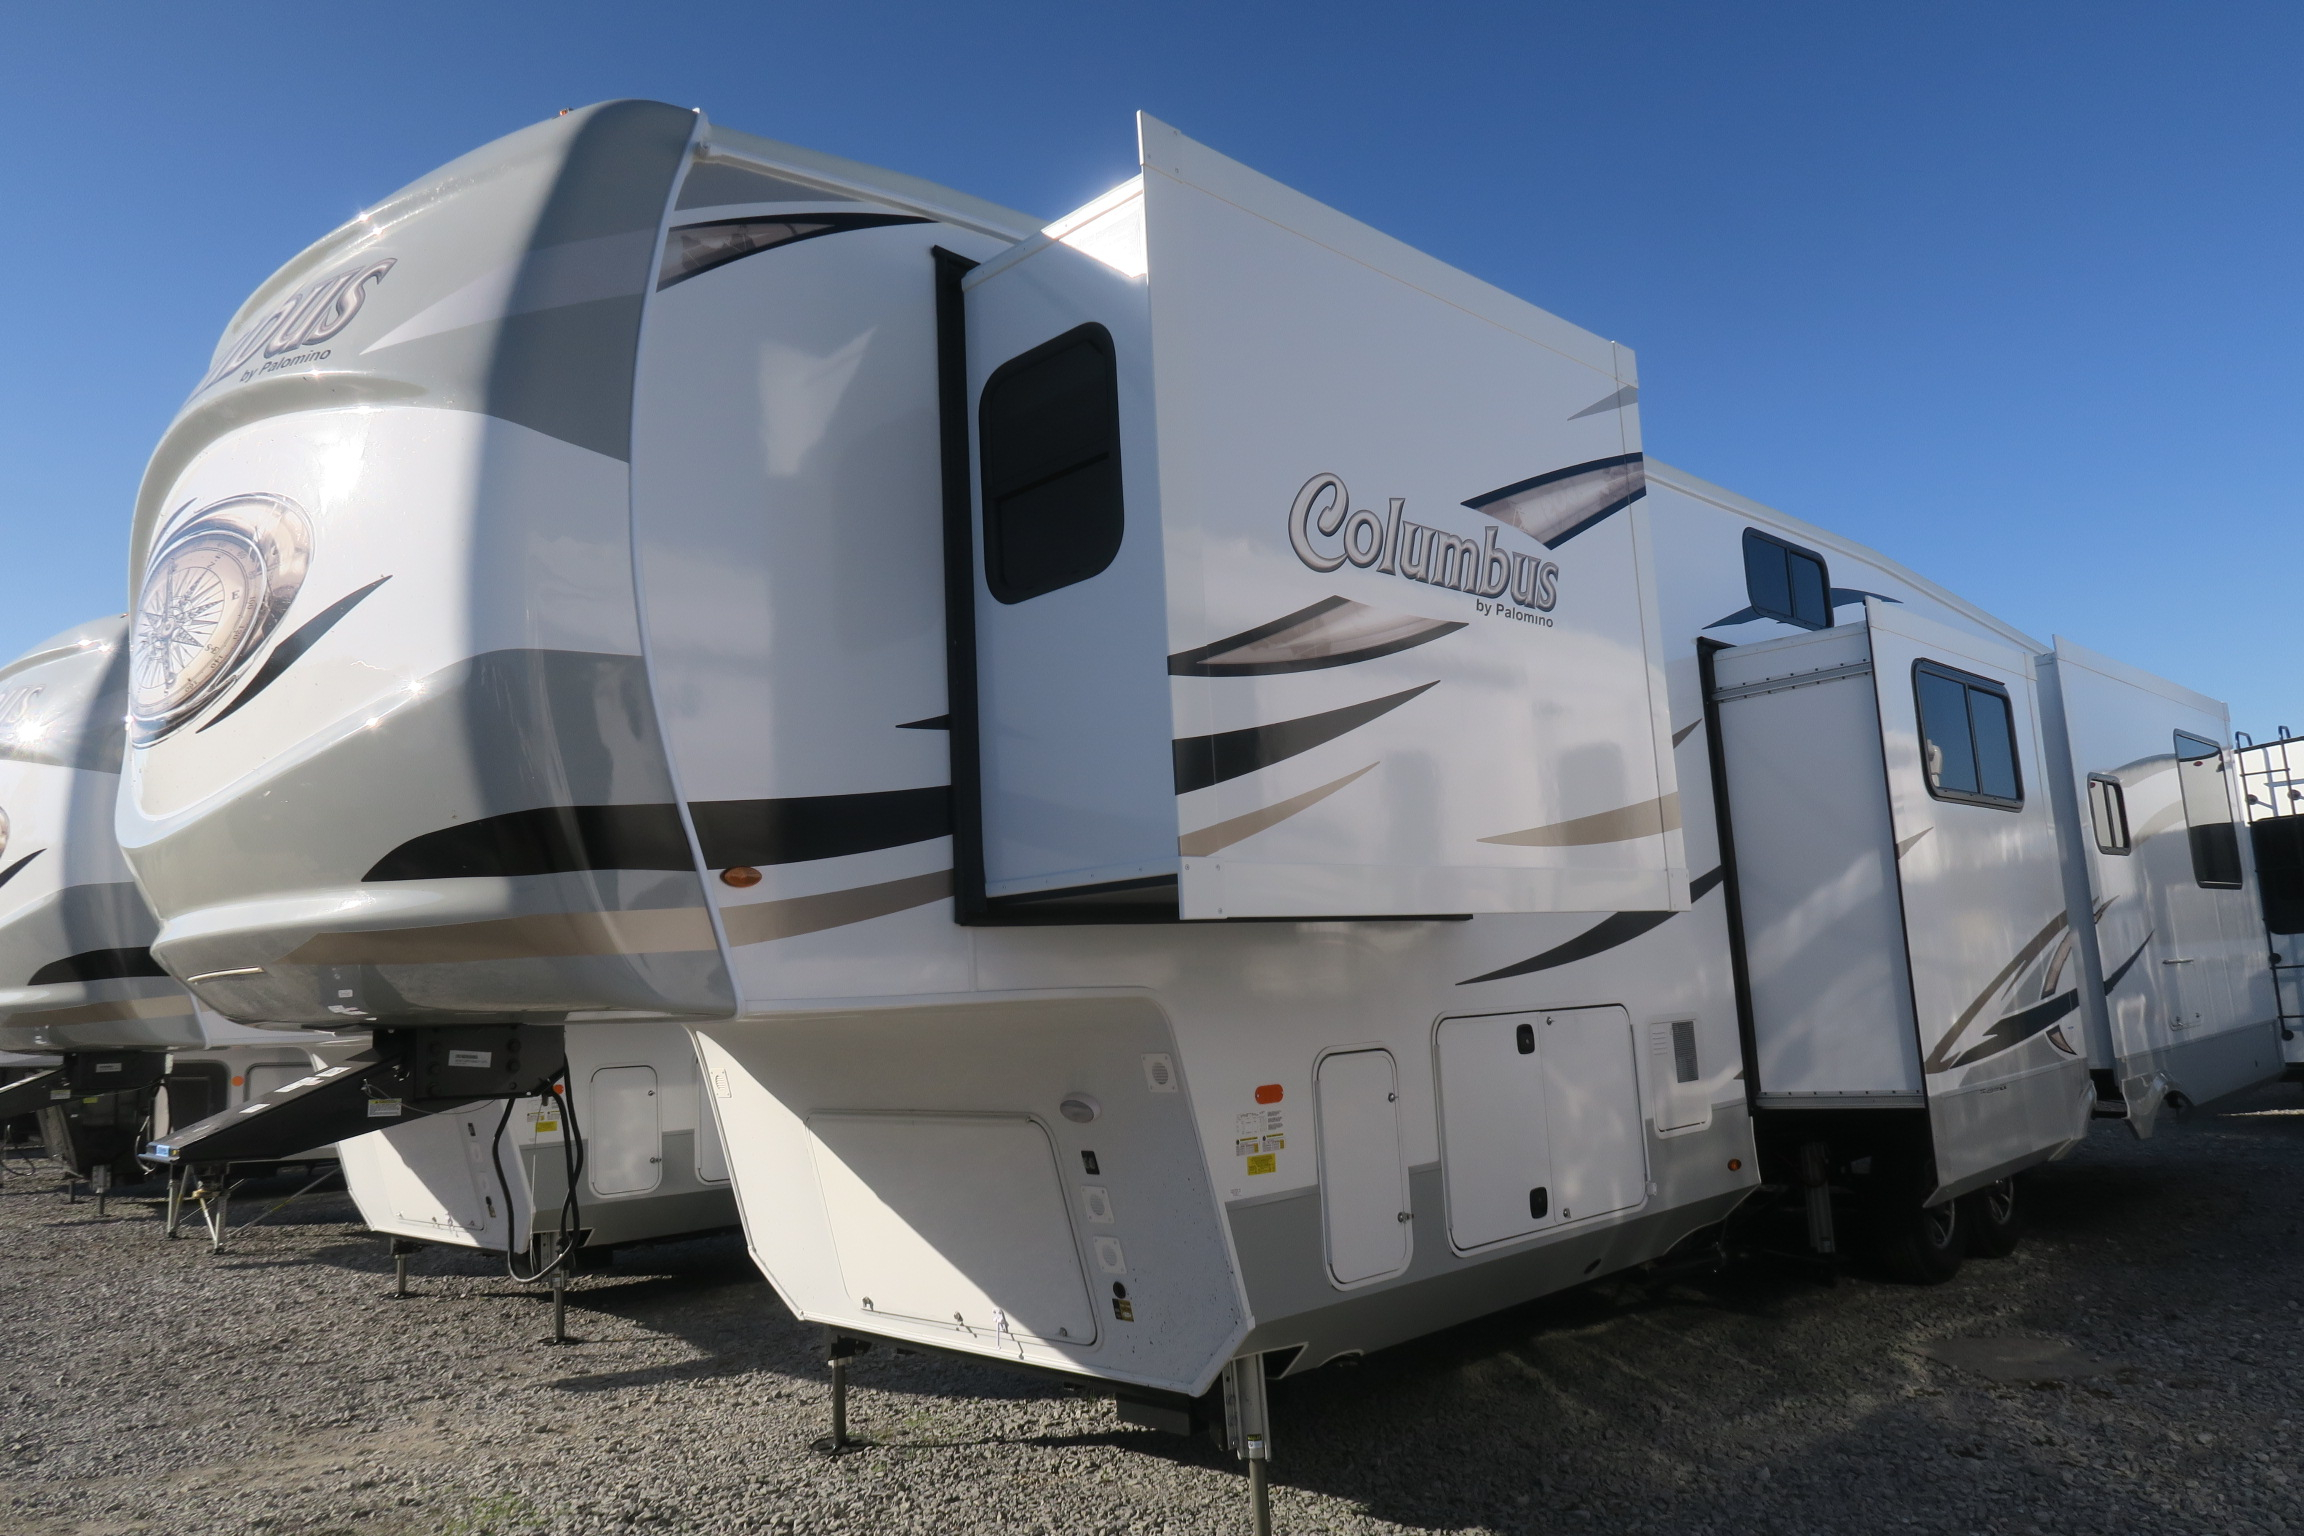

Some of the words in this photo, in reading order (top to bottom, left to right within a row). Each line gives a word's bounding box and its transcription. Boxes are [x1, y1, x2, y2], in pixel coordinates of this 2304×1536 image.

[239, 368, 259, 384] by
[258, 349, 332, 376] Palomino
[1288, 472, 1560, 613] Columbus
[231, 589, 241, 601] E
[1475, 598, 1493, 617] by
[1495, 603, 1555, 629] Palomino
